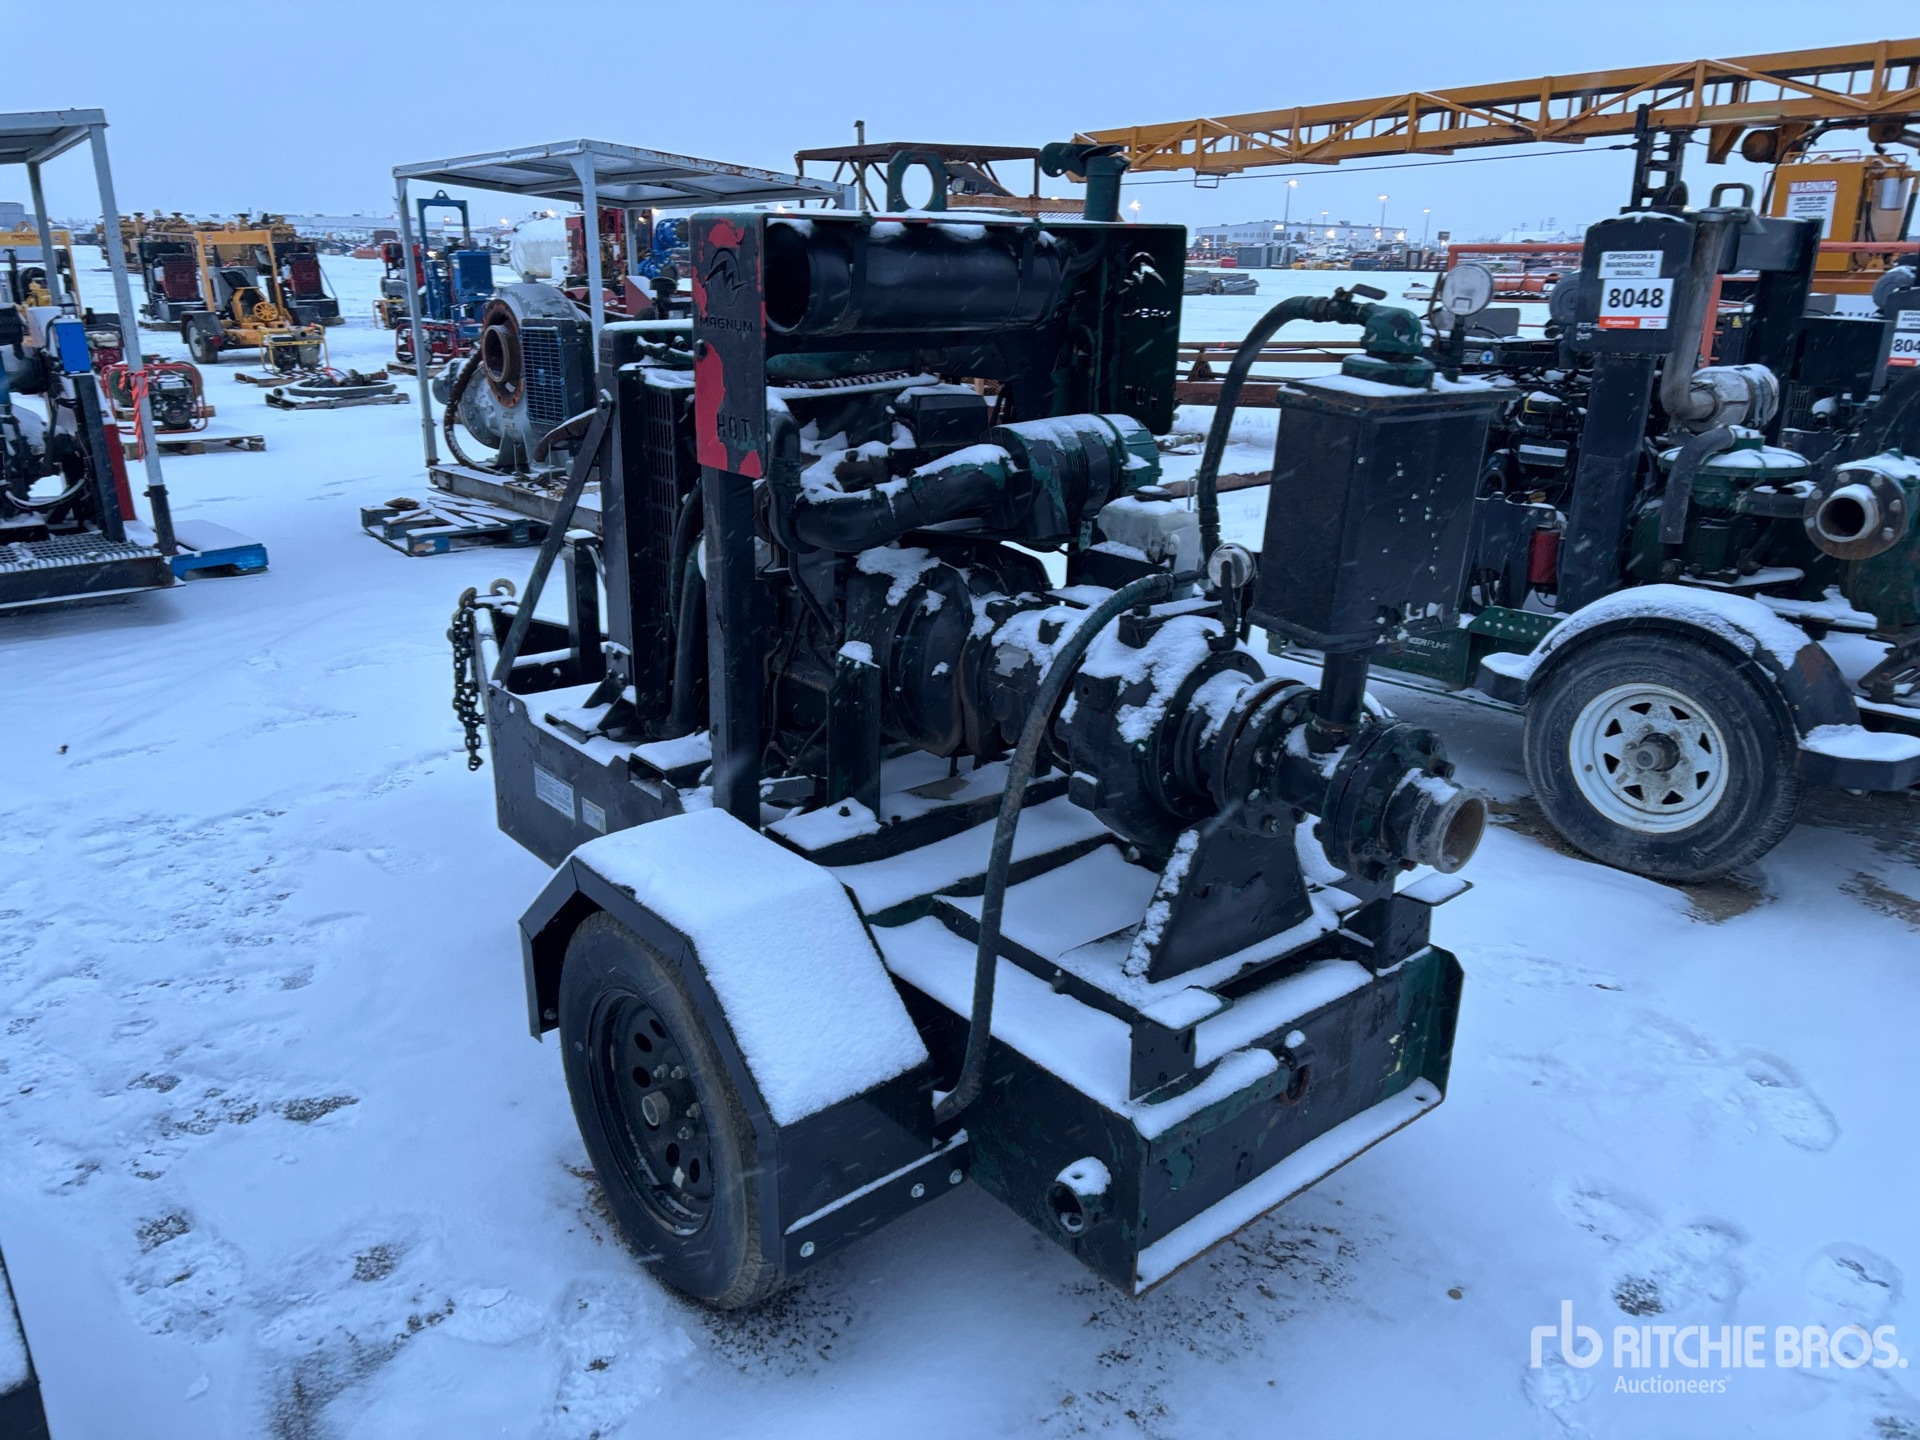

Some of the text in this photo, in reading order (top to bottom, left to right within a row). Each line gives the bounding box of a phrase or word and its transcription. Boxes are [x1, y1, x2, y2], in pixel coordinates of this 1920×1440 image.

[1791, 181, 1837, 192] WARNING
[1608, 288, 1664, 308] 8048
[700, 317, 753, 333] MAGNUM
[717, 414, 750, 442] HOT
